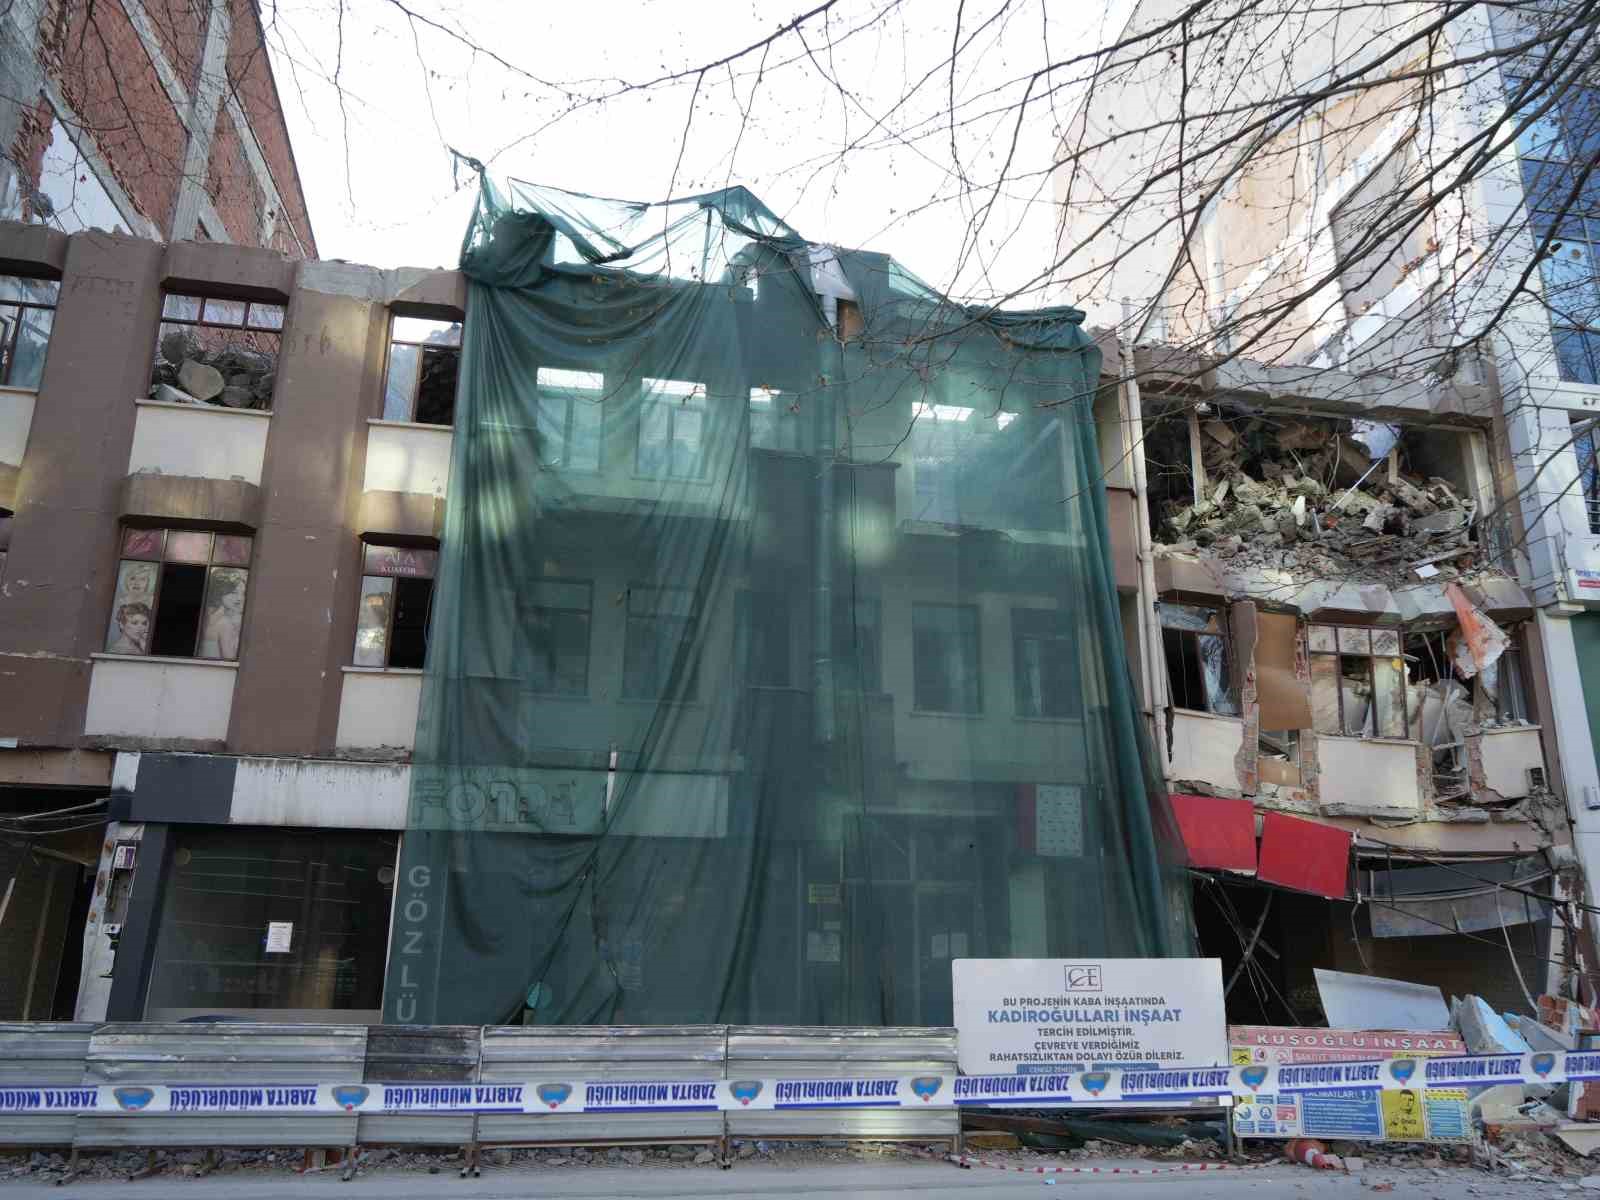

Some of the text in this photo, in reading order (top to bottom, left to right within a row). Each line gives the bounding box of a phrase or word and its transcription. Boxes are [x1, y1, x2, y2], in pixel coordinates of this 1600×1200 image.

[1003, 995, 1166, 1008] BU PROJENİN KABA İNŞAATINDA
[987, 1005, 1182, 1026] KADİROĞULLARI İNŞAAT
[1038, 1025, 1135, 1038] TERCİH EDİLMİŞTİR.
[1034, 1039, 1140, 1051] ÇEVREYE VERDİĞİMİZ
[989, 1049, 1185, 1062] RAHATSIZLIKTAN DOLAYI ÖZÜR DİLERİZ.
[1345, 1064, 1380, 1081] ZABITA
[1488, 1058, 1521, 1075] ZABITA
[1030, 1074, 1070, 1091] ZABITA
[1193, 1069, 1229, 1087] ZABITA
[44, 1089, 97, 1108] ZABITA
[384, 1087, 522, 1108] ZABITA MÜDÜRLÜĞÜ
[586, 1083, 716, 1105] ZABITA MÜDÜRLÜĞÜ
[775, 1080, 898, 1102] ZABITA MÜDÜRLÜĞÜ
[170, 1089, 317, 1111] ZABITA MÜDÜRLÜĞÜ
